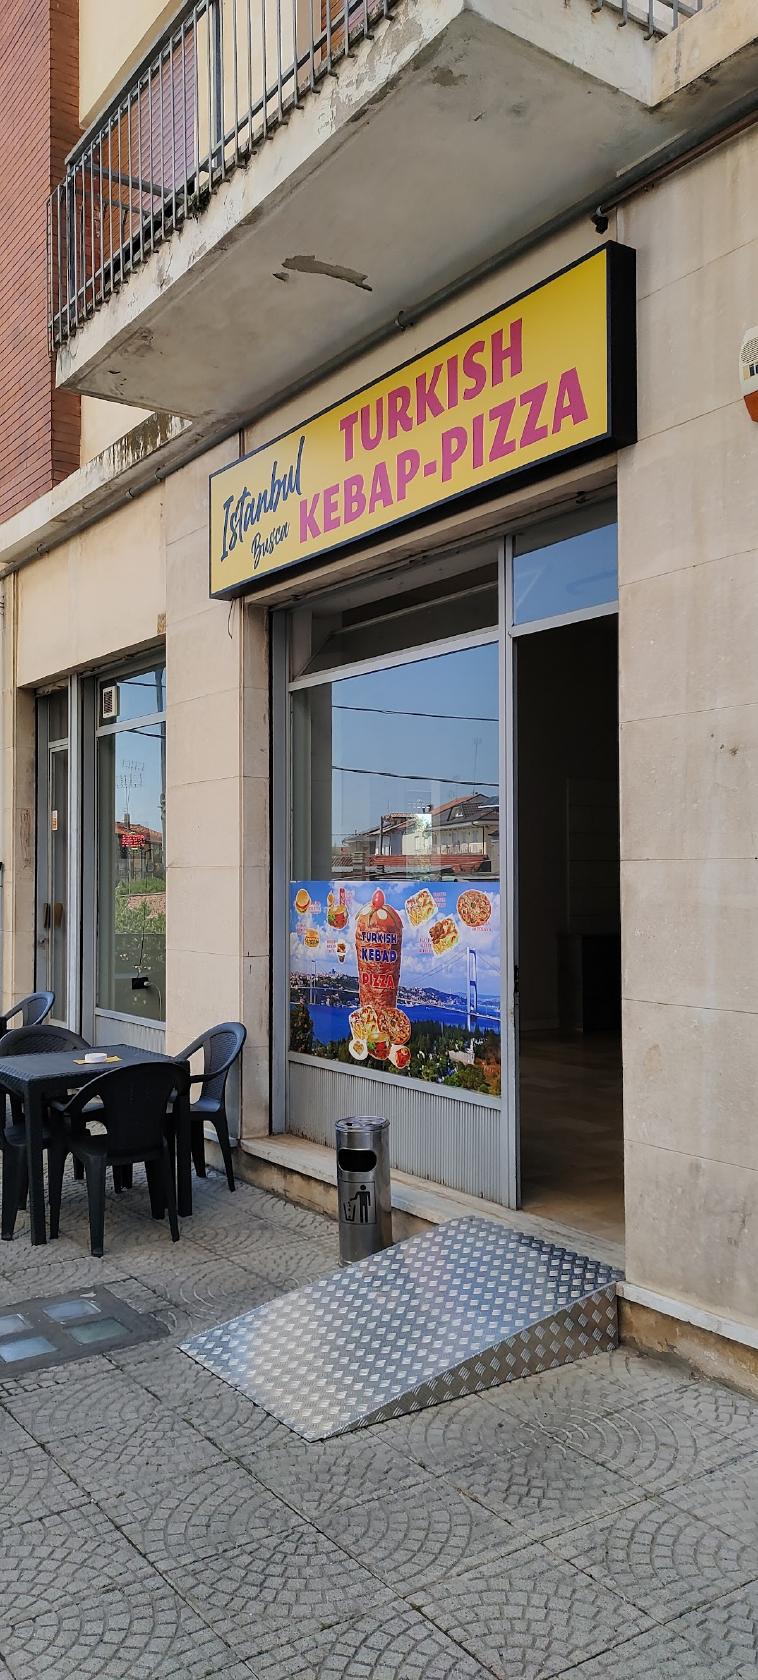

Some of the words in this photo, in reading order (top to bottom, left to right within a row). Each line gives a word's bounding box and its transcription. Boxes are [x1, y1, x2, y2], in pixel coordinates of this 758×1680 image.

[339, 317, 523, 462] TURKISH
[221, 435, 305, 562] Istanbul
[299, 367, 589, 544] KEBAP-PIZZA
[251, 522, 290, 569] Busca
[361, 931, 397, 944] TURKISH
[362, 972, 394, 988] PIZZA
